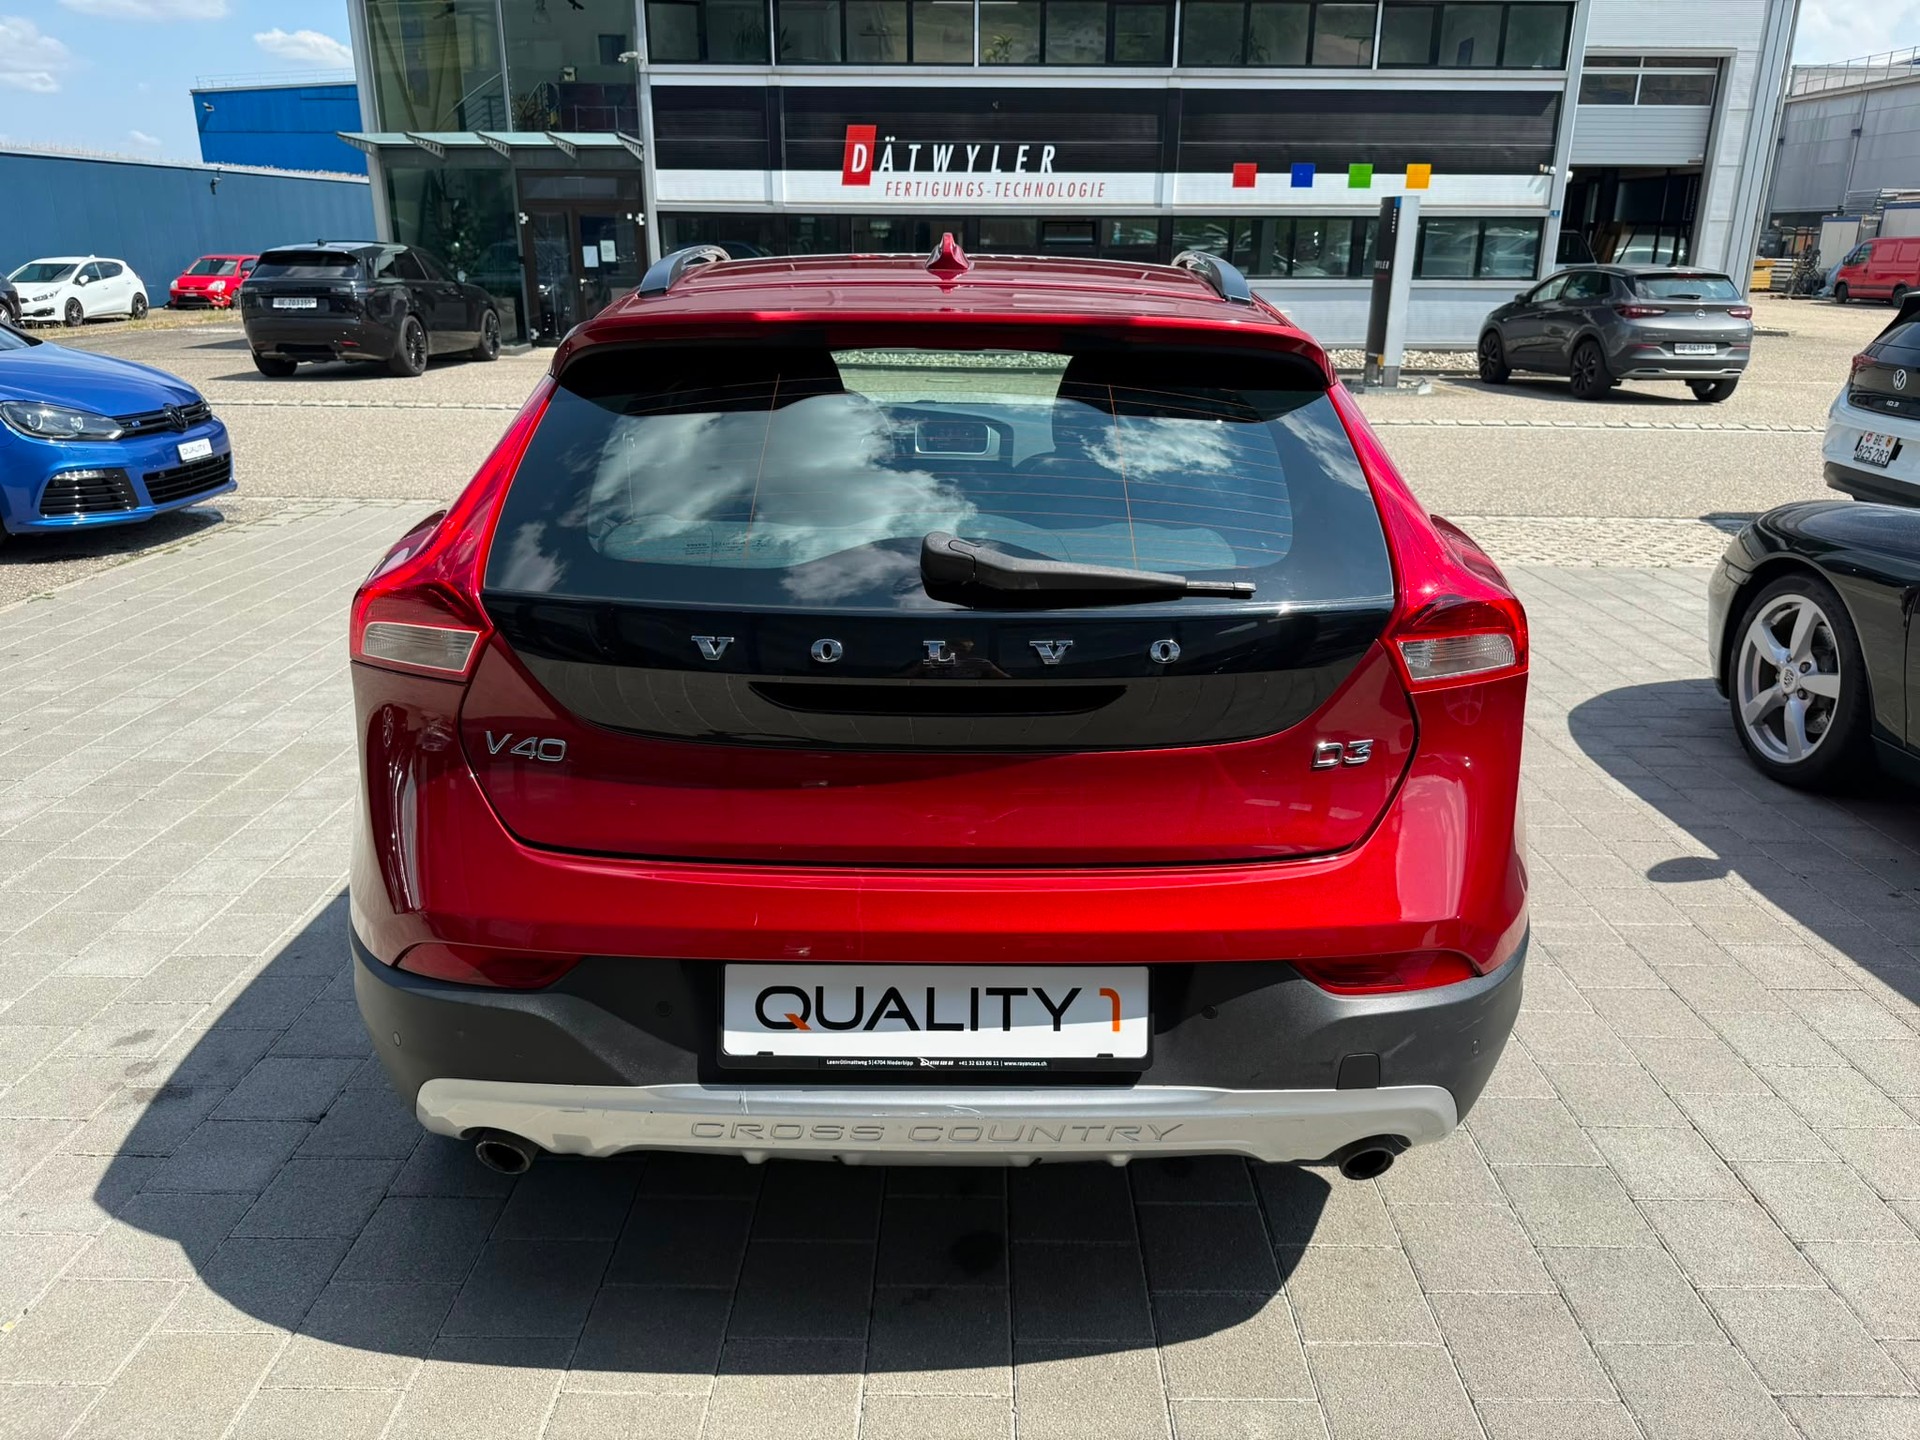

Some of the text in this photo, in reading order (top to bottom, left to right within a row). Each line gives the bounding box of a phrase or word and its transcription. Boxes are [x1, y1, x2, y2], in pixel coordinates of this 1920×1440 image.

[851, 136, 1056, 173] DÄTWYLER
[885, 181, 1106, 198] FERTIGUNGS-TECHNOLOGIE
[1873, 435, 1884, 447] BE
[690, 635, 1182, 666] VOLVO
[485, 730, 567, 762] V40
[1312, 739, 1374, 768] D3
[755, 985, 1121, 1032] QUALITY 1
[691, 1122, 1184, 1142] CROSS COUNTRY
